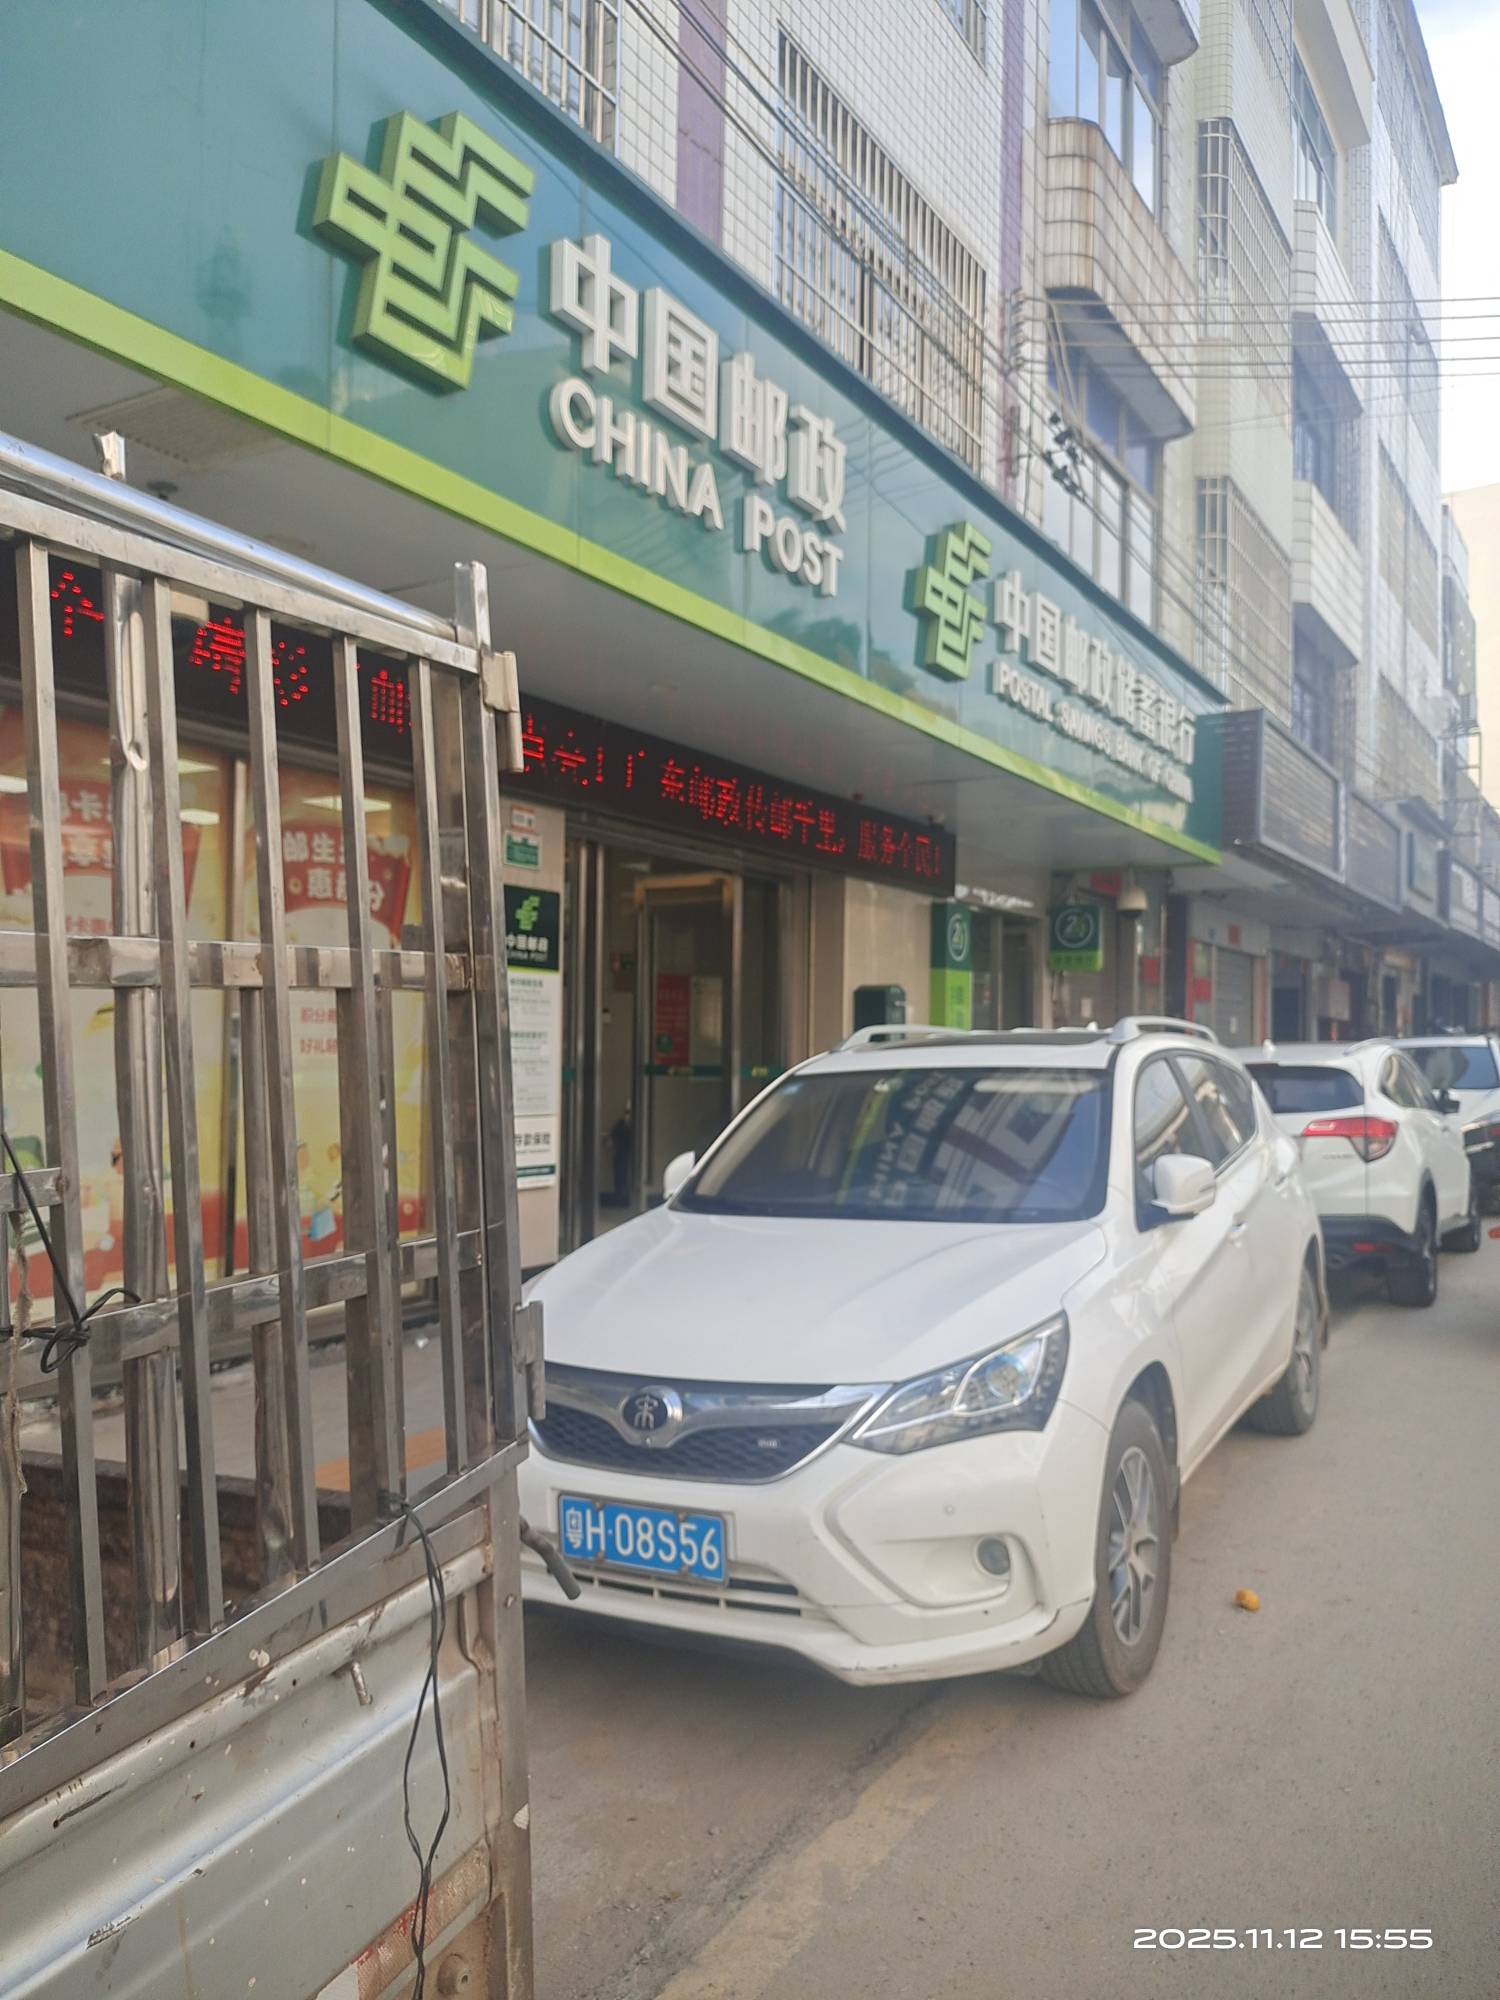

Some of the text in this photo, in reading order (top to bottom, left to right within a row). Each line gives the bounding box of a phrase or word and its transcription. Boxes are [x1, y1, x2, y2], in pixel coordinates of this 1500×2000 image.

[549, 377, 843, 597] CHINA POST
[550, 234, 847, 533] 中国邮政
[992, 660, 1054, 723] POSTAL
[993, 569, 1196, 765] 中国邮政储蓄银行
